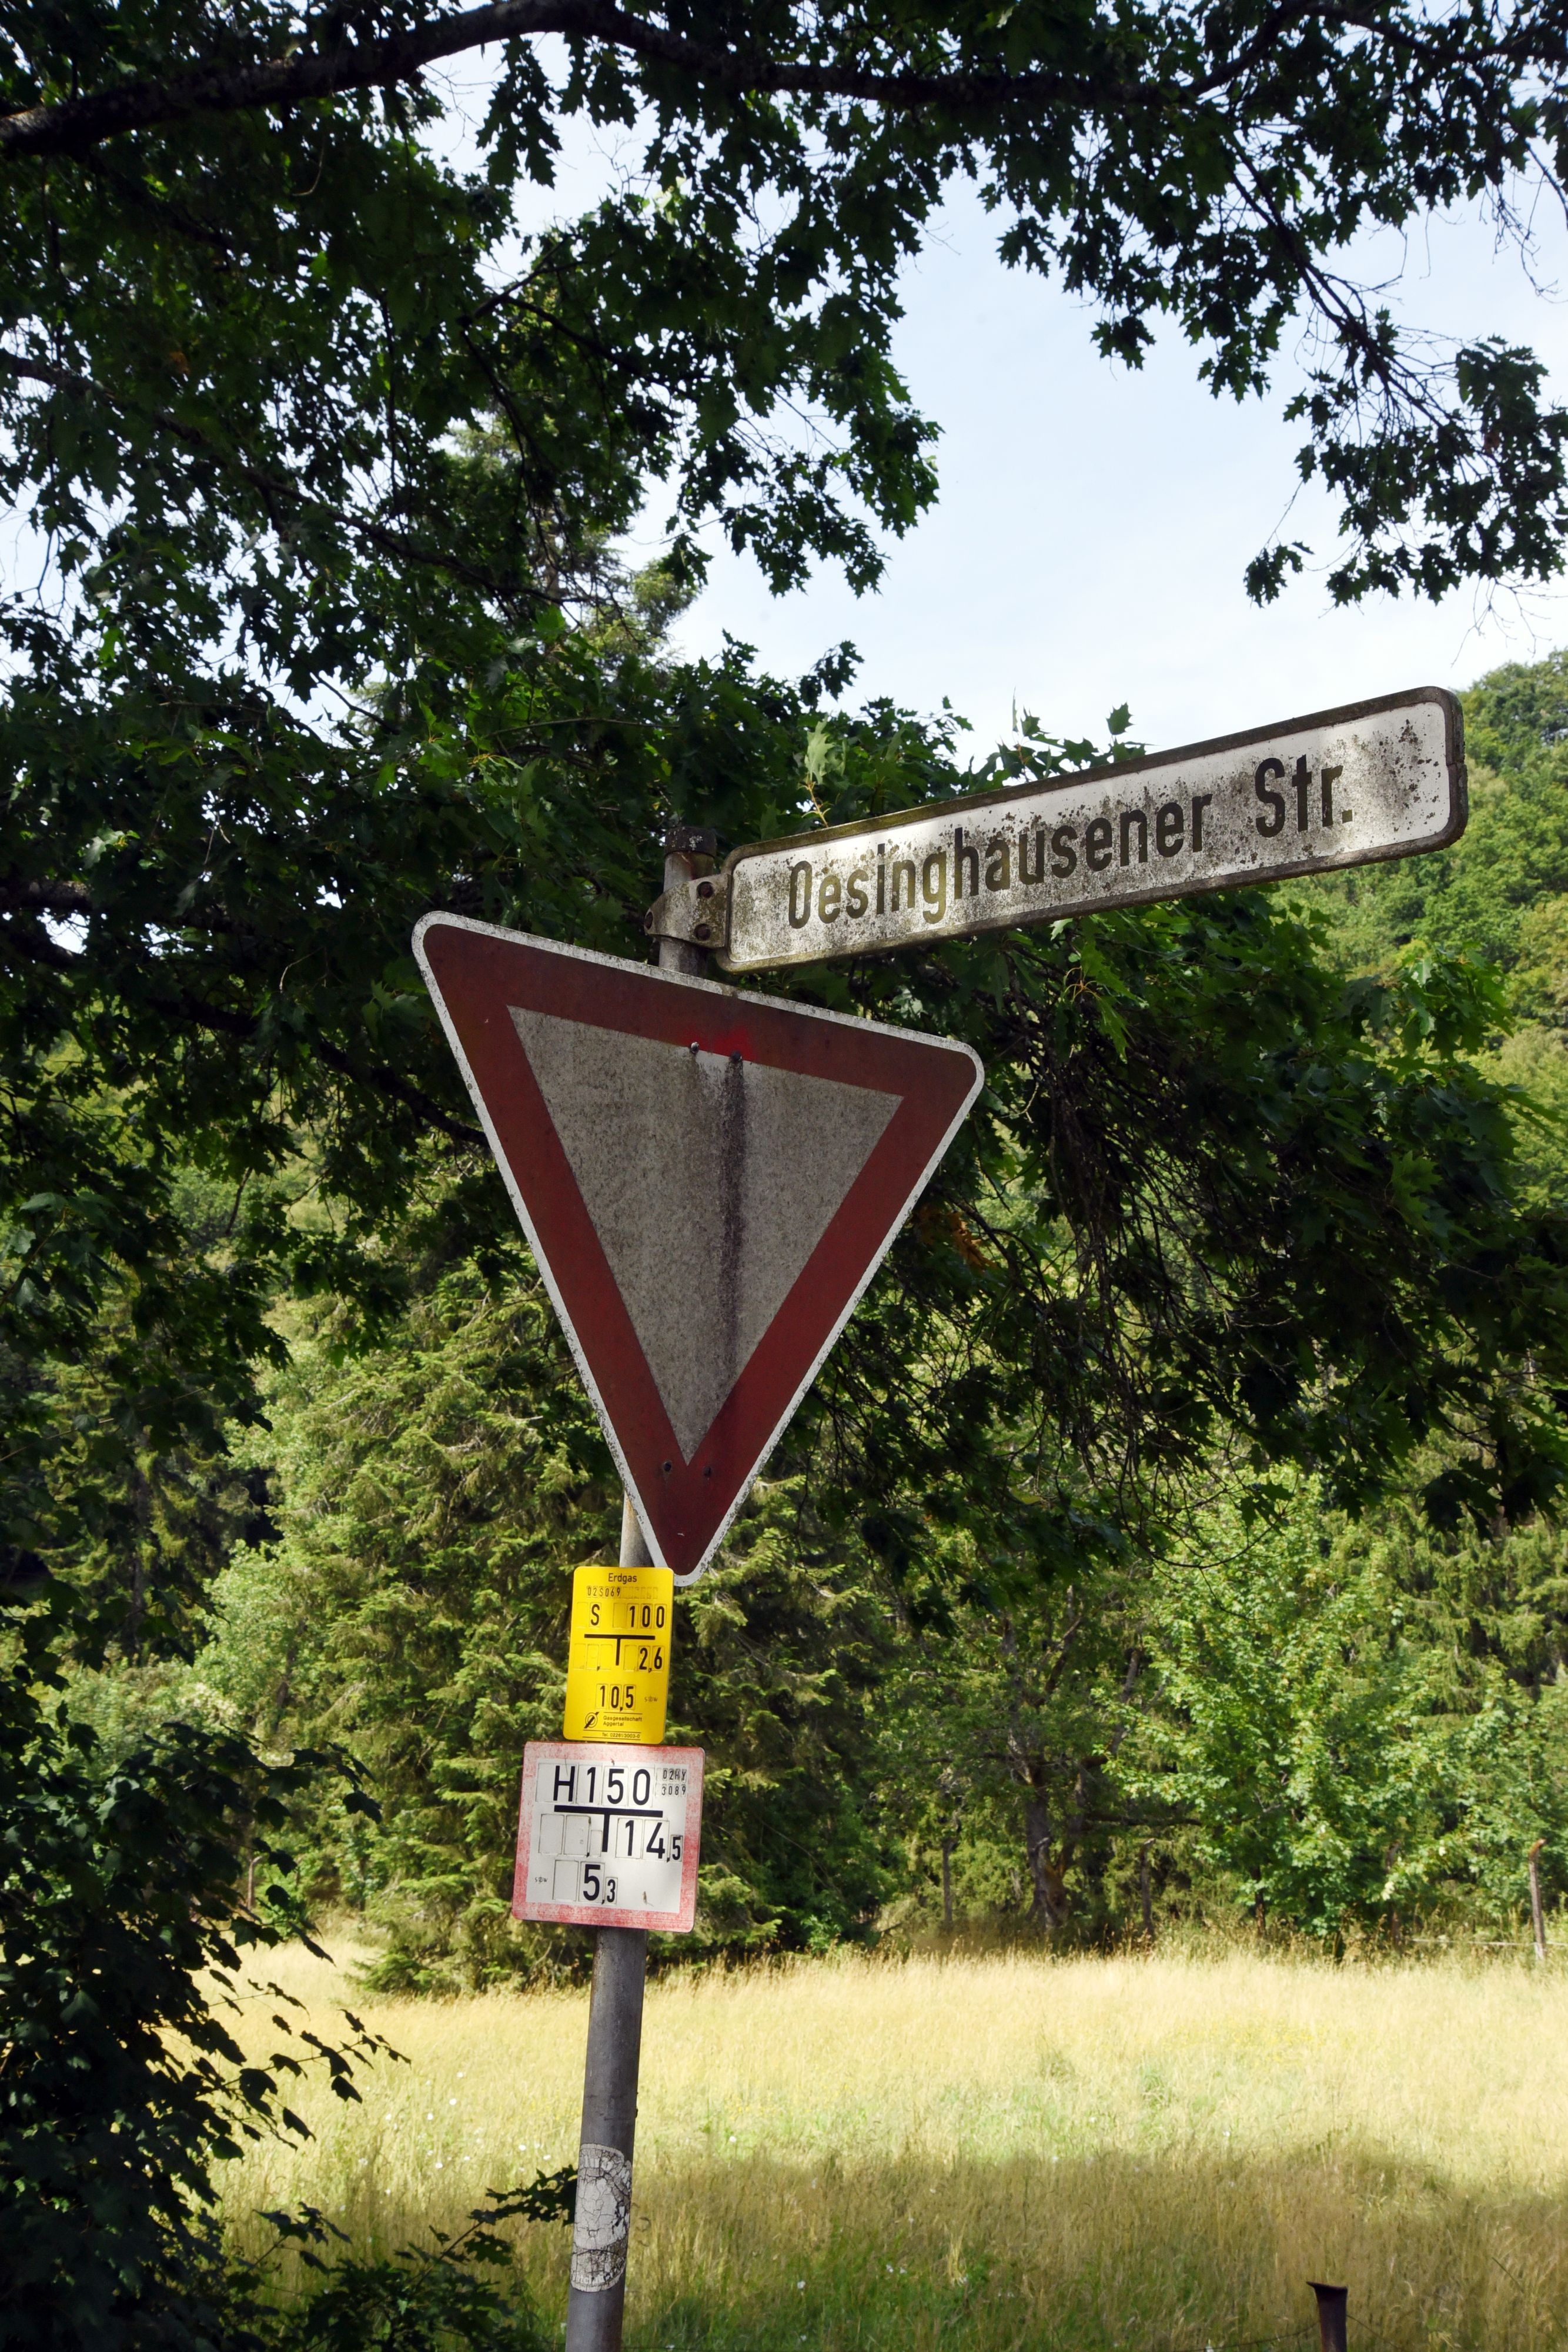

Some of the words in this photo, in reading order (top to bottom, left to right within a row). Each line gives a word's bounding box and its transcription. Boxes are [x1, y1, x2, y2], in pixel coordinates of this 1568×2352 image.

[788, 793, 1212, 929] Oesinghausener
[1255, 754, 1355, 838] Str.
[608, 1573, 637, 1584] Erdgas
[590, 1603, 600, 1626] S
[629, 1605, 664, 1628] 100
[639, 1647, 663, 1673] 2,6
[600, 1685, 634, 1712] 10,5
[661, 1785, 686, 1796] 3089
[583, 1864, 616, 1905] 5,3
